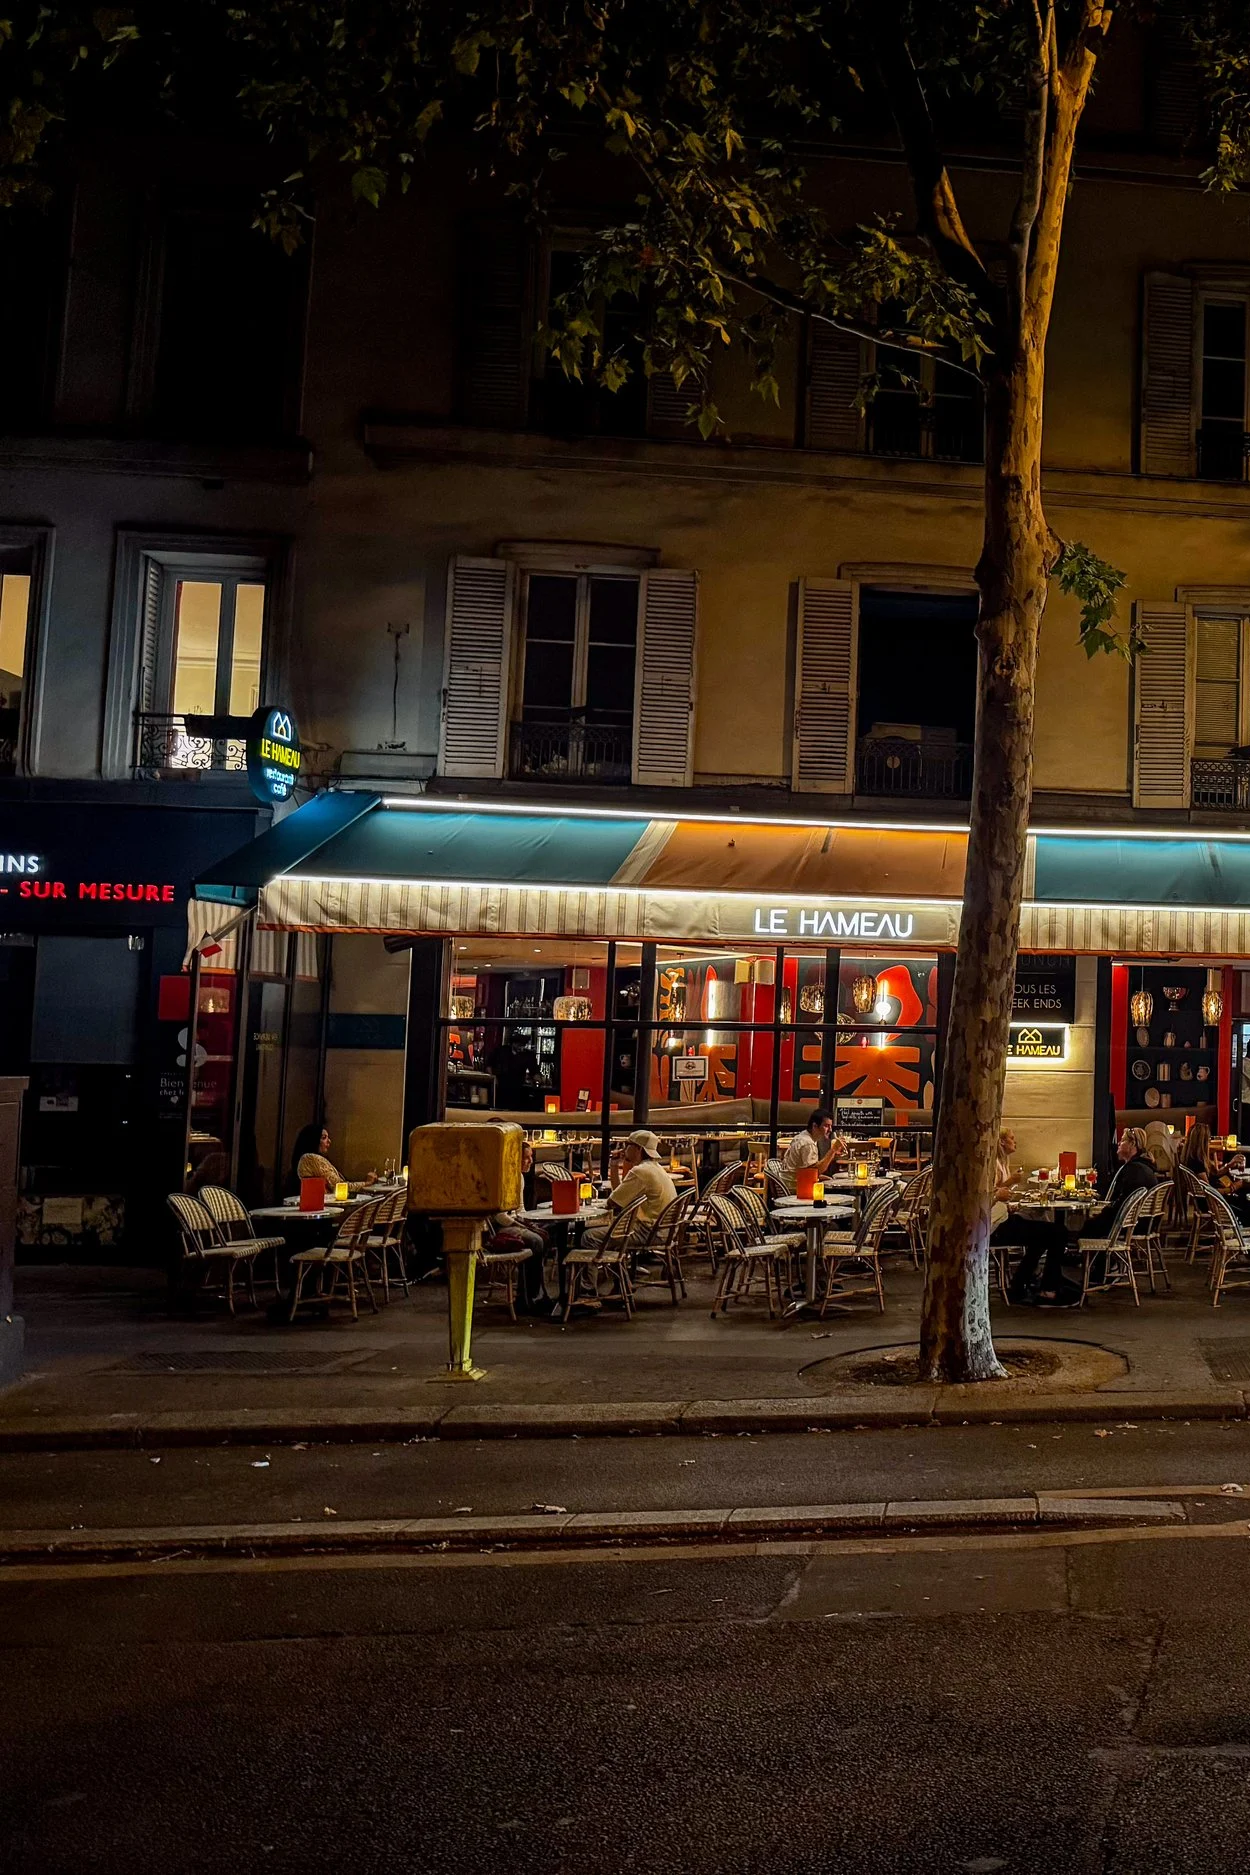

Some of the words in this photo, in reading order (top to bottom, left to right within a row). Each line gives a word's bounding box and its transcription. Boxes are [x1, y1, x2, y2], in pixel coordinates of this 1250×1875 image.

[261, 738, 271, 759] LE
[20, 880, 67, 901] SUR
[79, 881, 175, 903] MESURE
[754, 907, 789, 934] LE
[798, 909, 915, 938] HAMEAU
[1020, 955, 1071, 967] UNCH
[1014, 984, 1037, 994] OUS
[1039, 984, 1057, 995] LES
[1012, 998, 1031, 1009] EEK
[1033, 998, 1063, 1010] ENDS
[1007, 1045, 1014, 1055] E
[1016, 1045, 1061, 1056] HAMEAU
[159, 1077, 217, 1090] Bienenue
